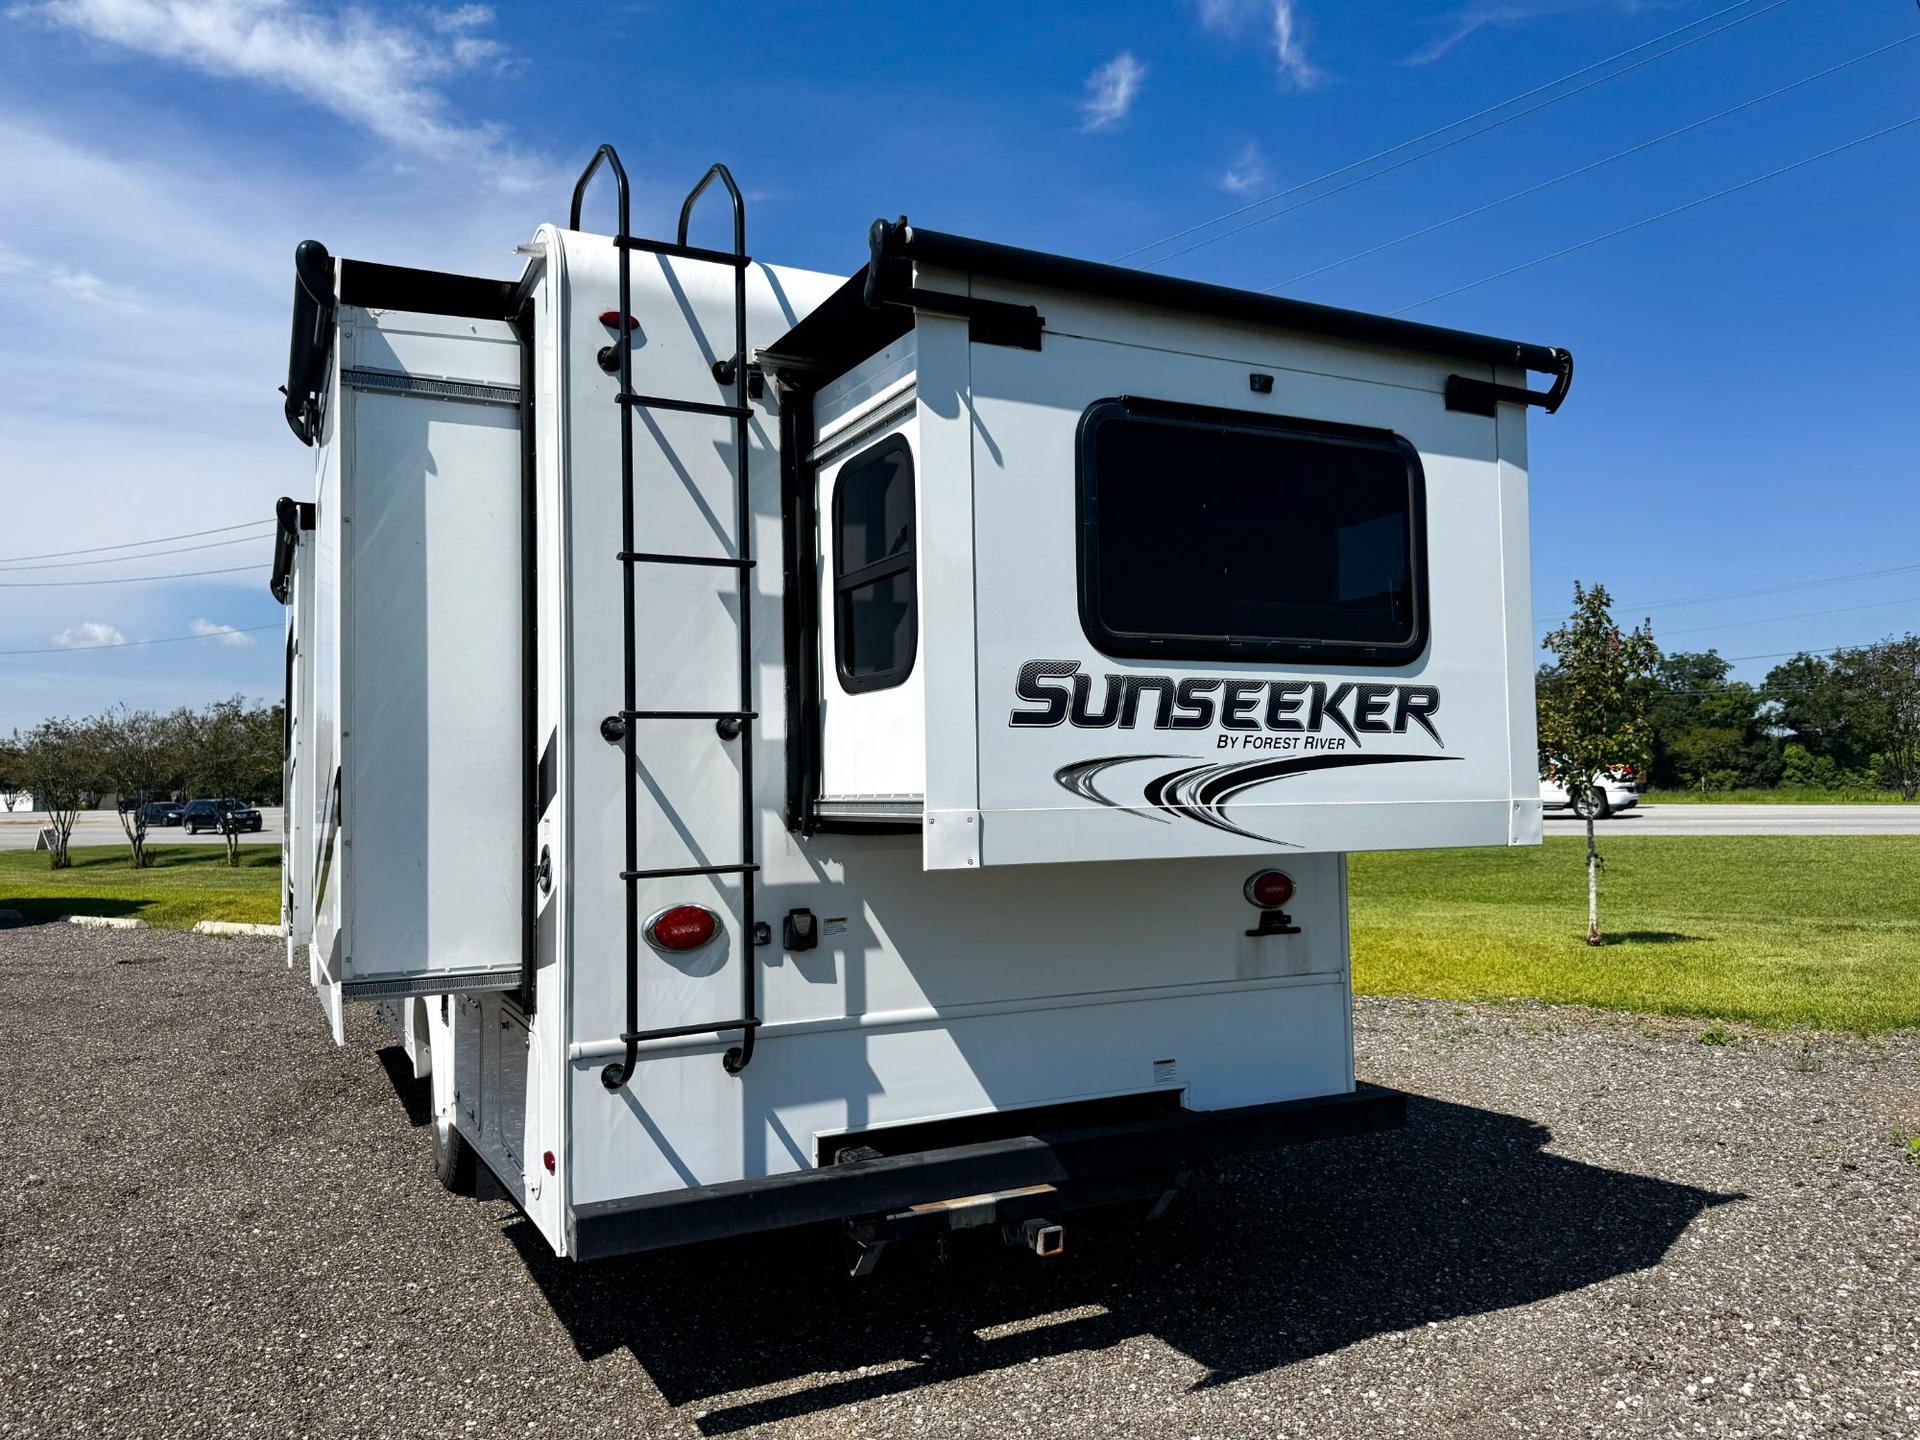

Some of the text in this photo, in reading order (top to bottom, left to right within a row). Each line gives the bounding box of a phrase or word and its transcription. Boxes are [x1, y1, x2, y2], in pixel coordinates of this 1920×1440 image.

[1009, 659, 1444, 748] SUNSEEKER
[1217, 734, 1346, 750] BY FOREST RIVER
